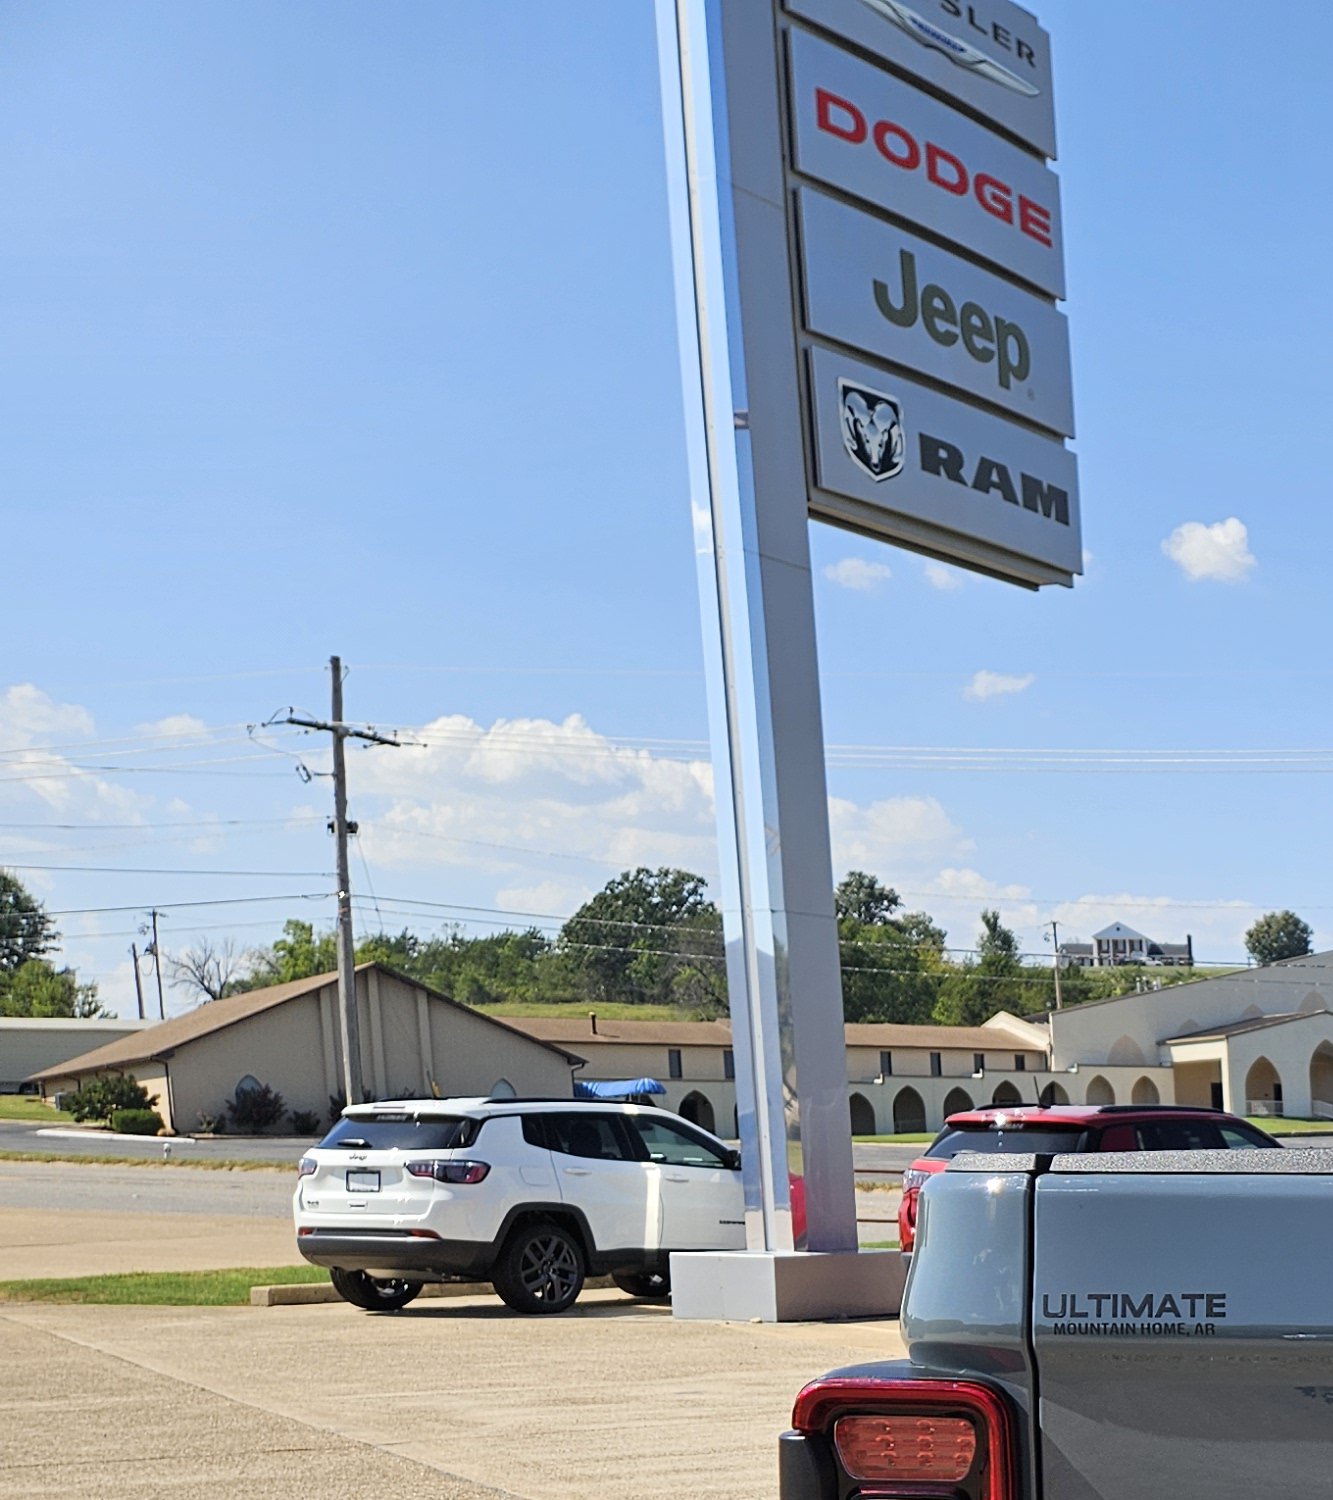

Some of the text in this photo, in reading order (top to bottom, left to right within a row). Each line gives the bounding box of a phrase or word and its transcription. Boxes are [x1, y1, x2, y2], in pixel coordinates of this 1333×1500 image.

[814, 87, 1053, 248] DODGE
[873, 249, 1031, 390] Jeep
[918, 436, 1070, 527] RAM
[1043, 1293, 1226, 1318] ULTIMATE
[1053, 1322, 1216, 1338] MOUNTAIN HOME, AR
